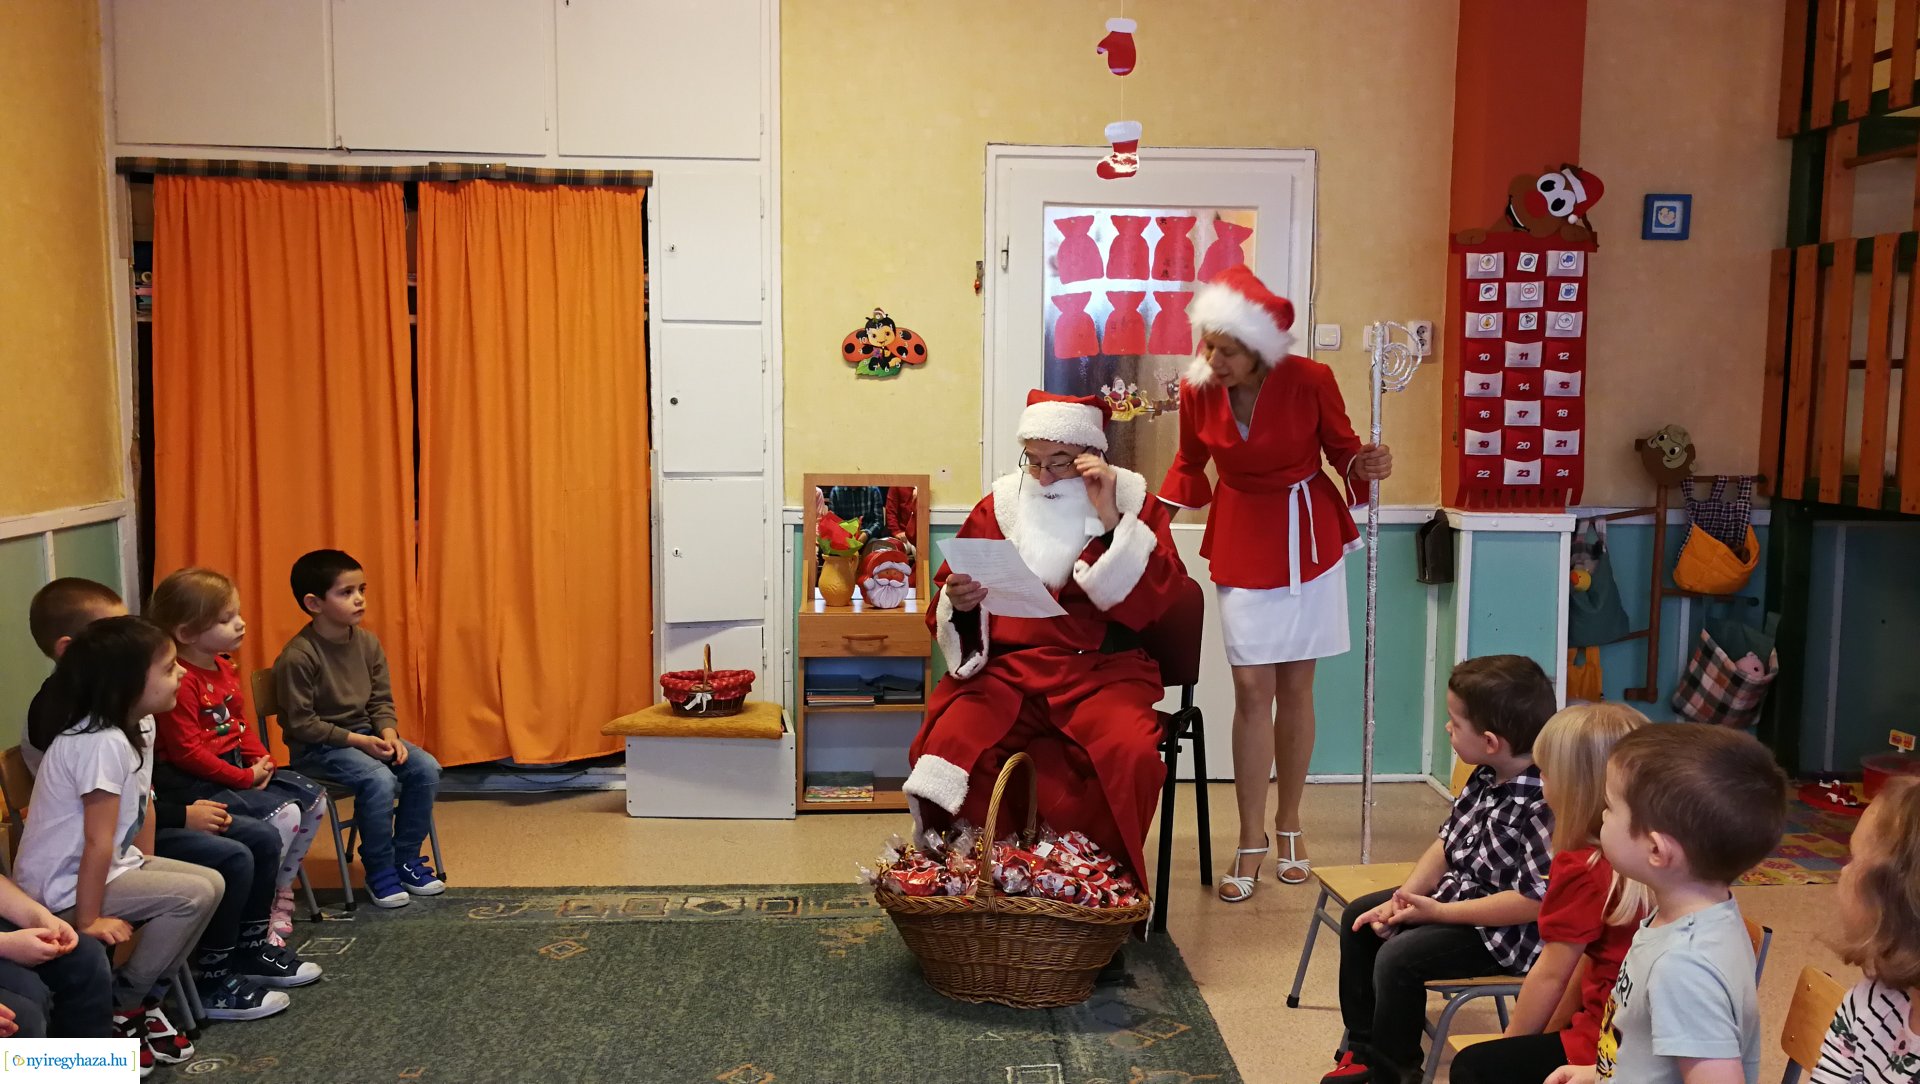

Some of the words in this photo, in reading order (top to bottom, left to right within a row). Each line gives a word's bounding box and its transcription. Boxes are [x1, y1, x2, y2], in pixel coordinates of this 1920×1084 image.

[1479, 352, 1490, 361] 10
[1518, 352, 1529, 360] 11
[1558, 352, 1570, 360] 12
[1479, 382, 1490, 390] 13
[1518, 382, 1530, 391] 14
[1559, 381, 1570, 389] 15
[1479, 410, 1490, 418] 16
[1517, 410, 1528, 418] 17
[1557, 409, 1568, 417] 18
[1478, 440, 1489, 448] 19
[1516, 441, 1530, 449] 20
[1476, 470, 1490, 478] 22
[1516, 469, 1530, 477] 23
[1556, 469, 1569, 477] 24
